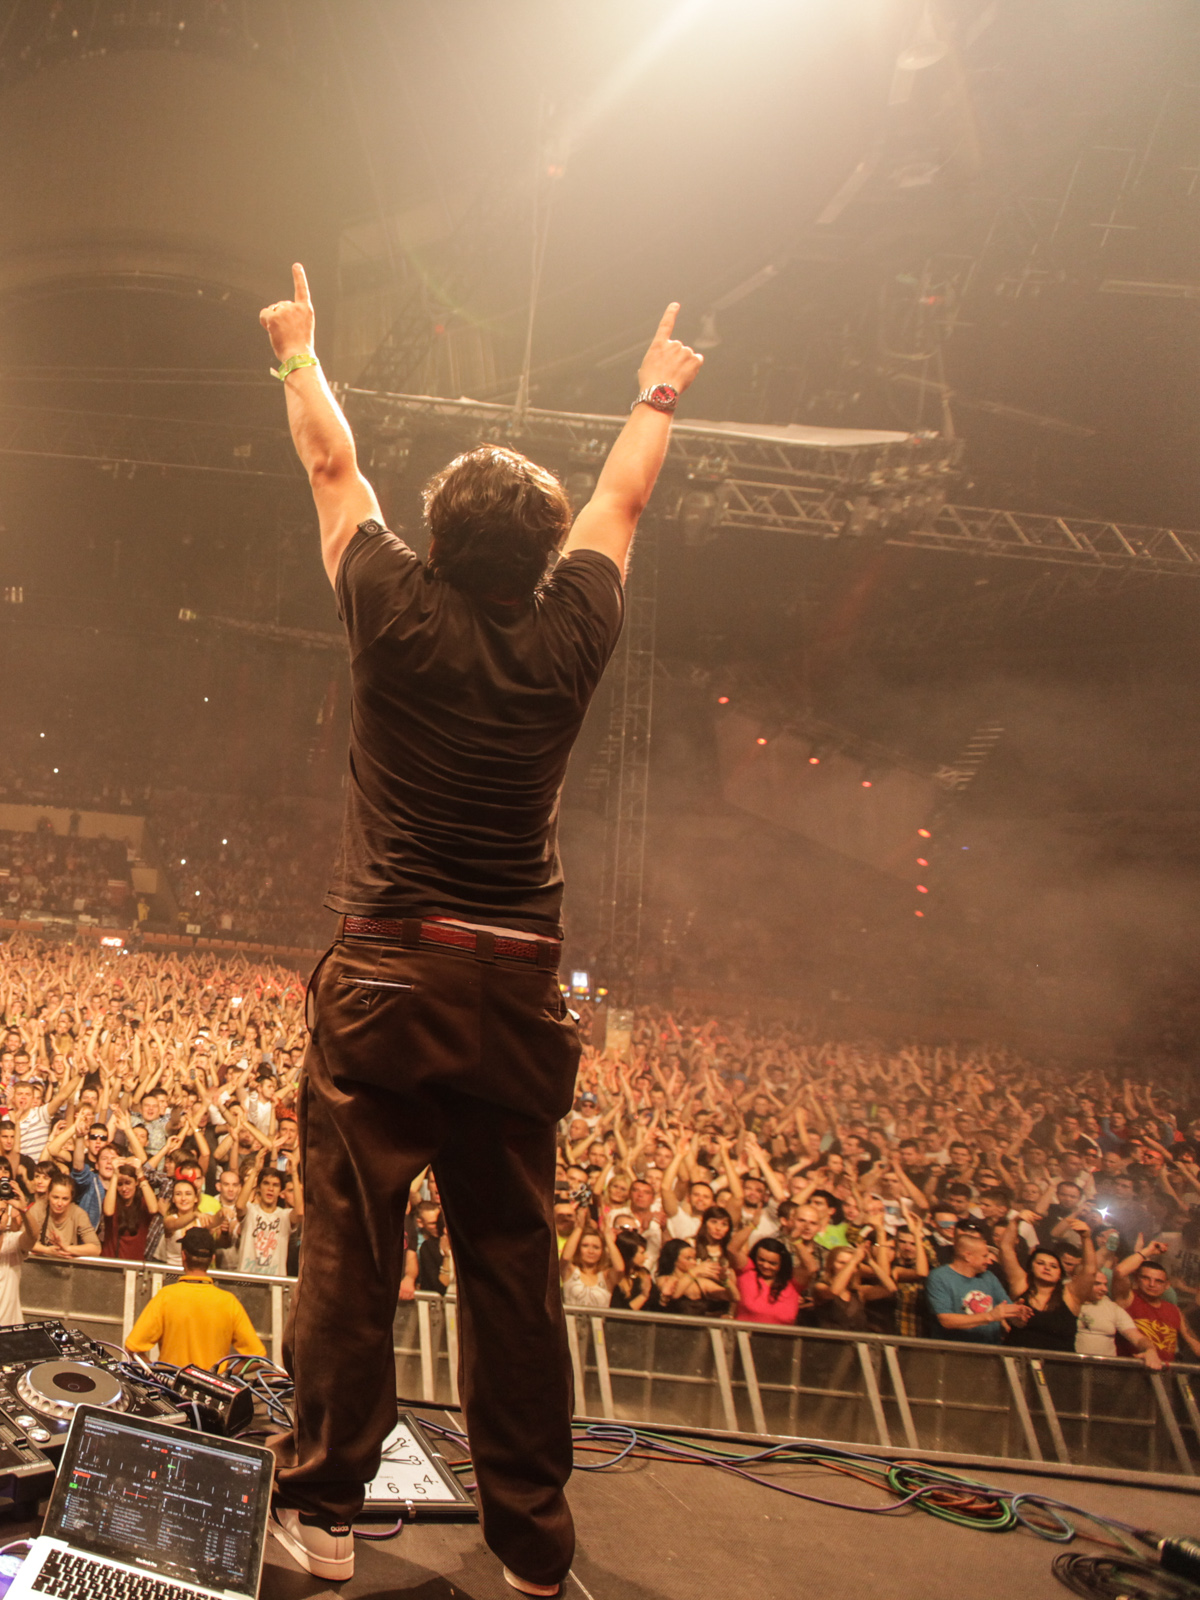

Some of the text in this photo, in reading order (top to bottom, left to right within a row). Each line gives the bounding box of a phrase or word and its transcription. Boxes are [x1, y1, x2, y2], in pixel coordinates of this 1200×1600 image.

[397, 1437, 410, 1448] 2
[408, 1455, 422, 1466] 3
[423, 1474, 434, 1486] 4
[386, 1482, 400, 1494] 6
[413, 1483, 427, 1495] 5
